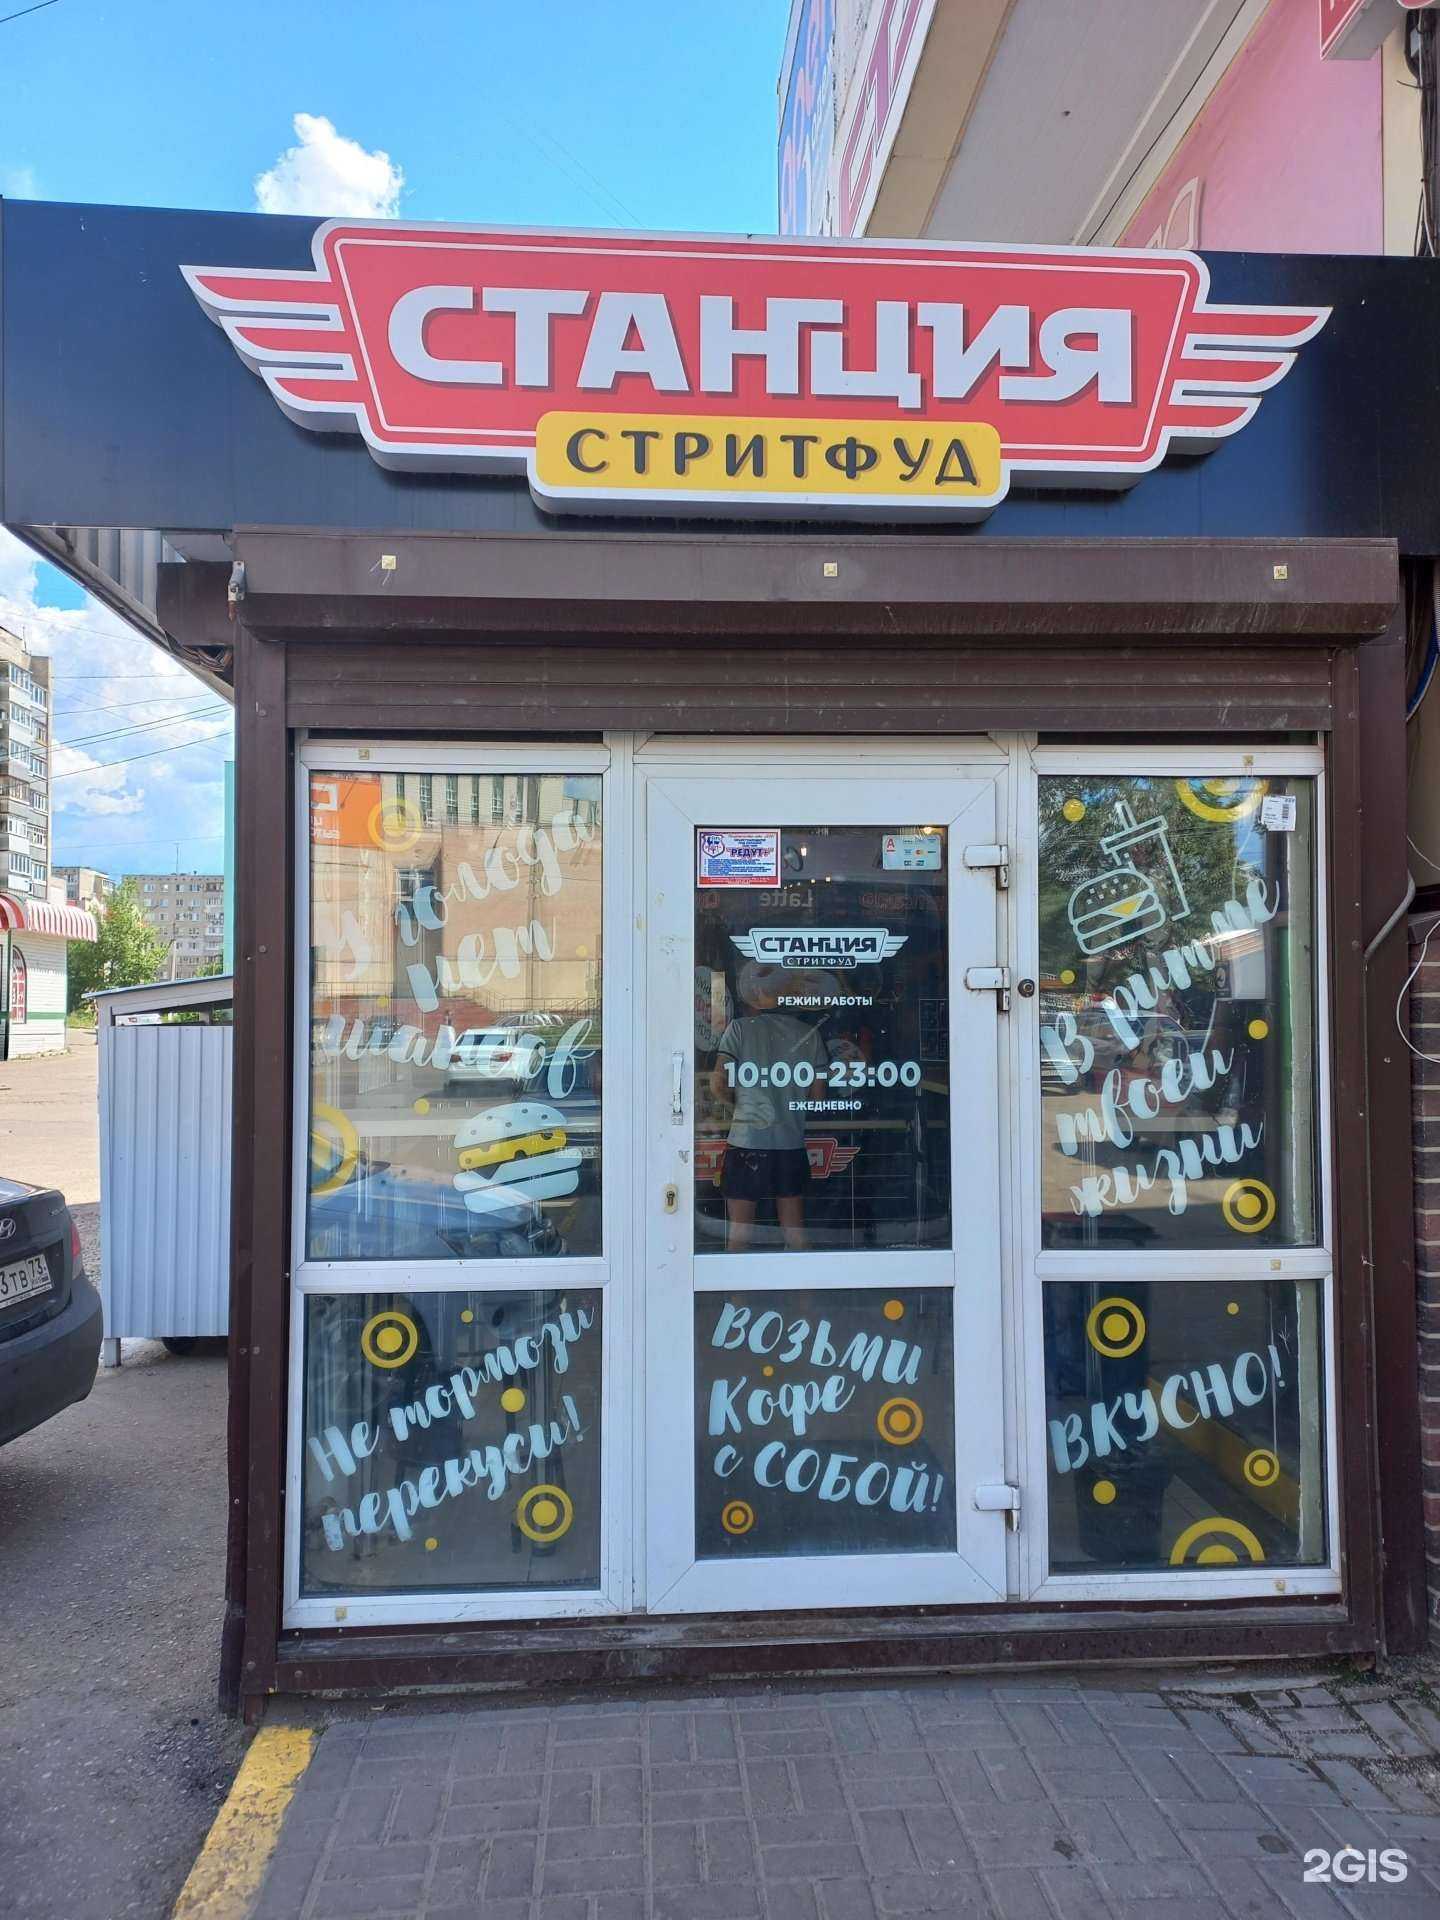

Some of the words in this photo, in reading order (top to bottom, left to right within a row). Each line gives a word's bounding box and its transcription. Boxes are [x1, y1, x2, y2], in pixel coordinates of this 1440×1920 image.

[387, 284, 1133, 409] СТАНЦИЯ
[566, 427, 979, 487] СТРИТФУД
[405, 915, 557, 1014] нет
[759, 937, 877, 955] СТАНЦИЯ
[786, 957, 853, 967] СТРИТФУД
[1040, 1012, 1095, 1086] В
[1101, 878, 1281, 1051] ритме
[777, 996, 822, 1006] РЕЖИМ
[824, 996, 873, 1006] РАБОТЫ
[723, 1061, 922, 1088] 10:00-23:00
[788, 1100, 862, 1112] ЕЖЕДНЕВНО
[1069, 1121, 1264, 1218] жизни
[308, 1421, 380, 1482] Не
[389, 1306, 595, 1442] тормози
[1048, 1344, 1287, 1475] ВКУСНО!
[321, 1395, 585, 1552] перекуси!
[713, 1444, 744, 1478] с
[753, 1441, 944, 1513] СОБОЙ!
